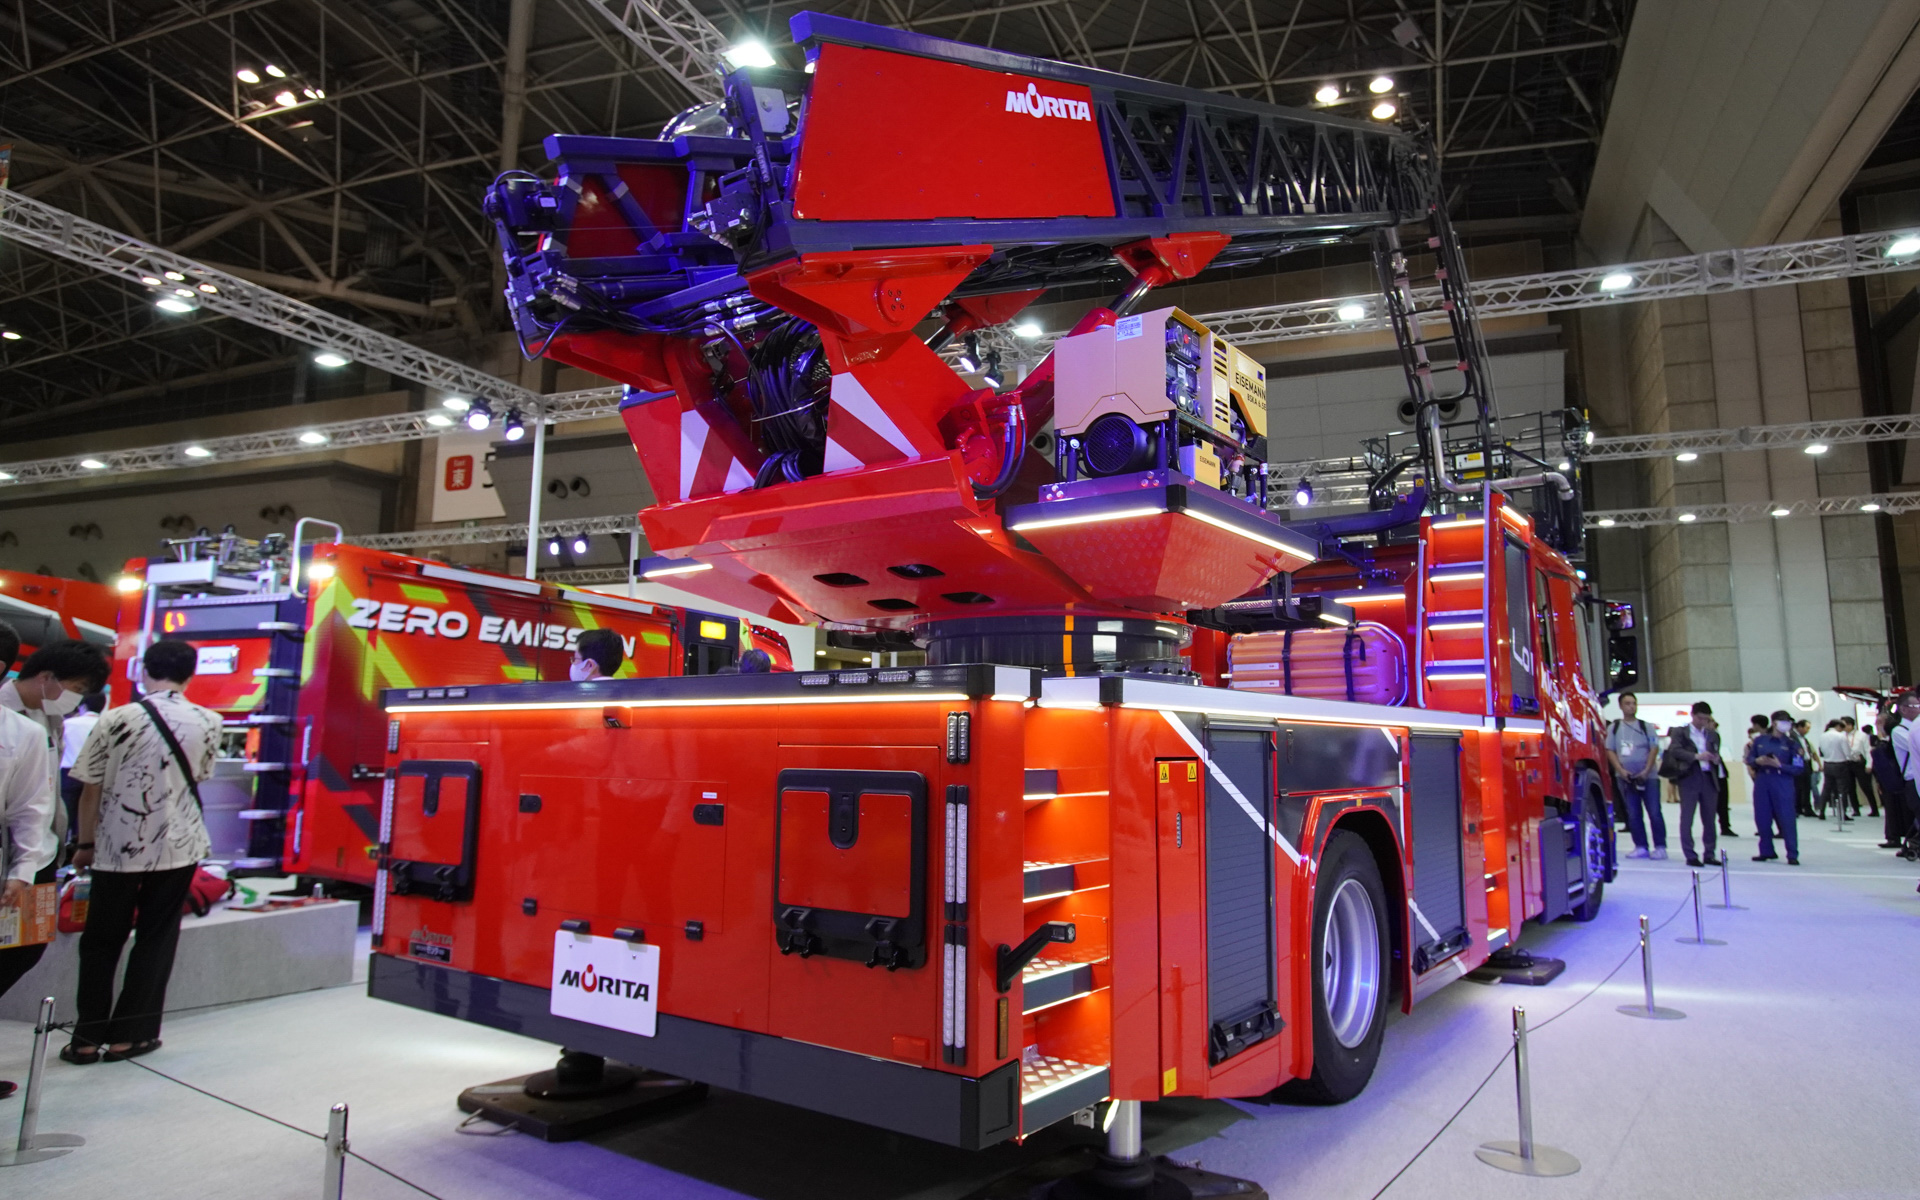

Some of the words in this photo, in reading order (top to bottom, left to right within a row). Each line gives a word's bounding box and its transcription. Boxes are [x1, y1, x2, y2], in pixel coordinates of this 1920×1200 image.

[1005, 82, 1091, 121] MORITA
[1235, 372, 1266, 400] EISEMANN
[348, 598, 469, 639] ZERO
[477, 616, 636, 658] EMISSN
[559, 963, 649, 1002] MORITA
